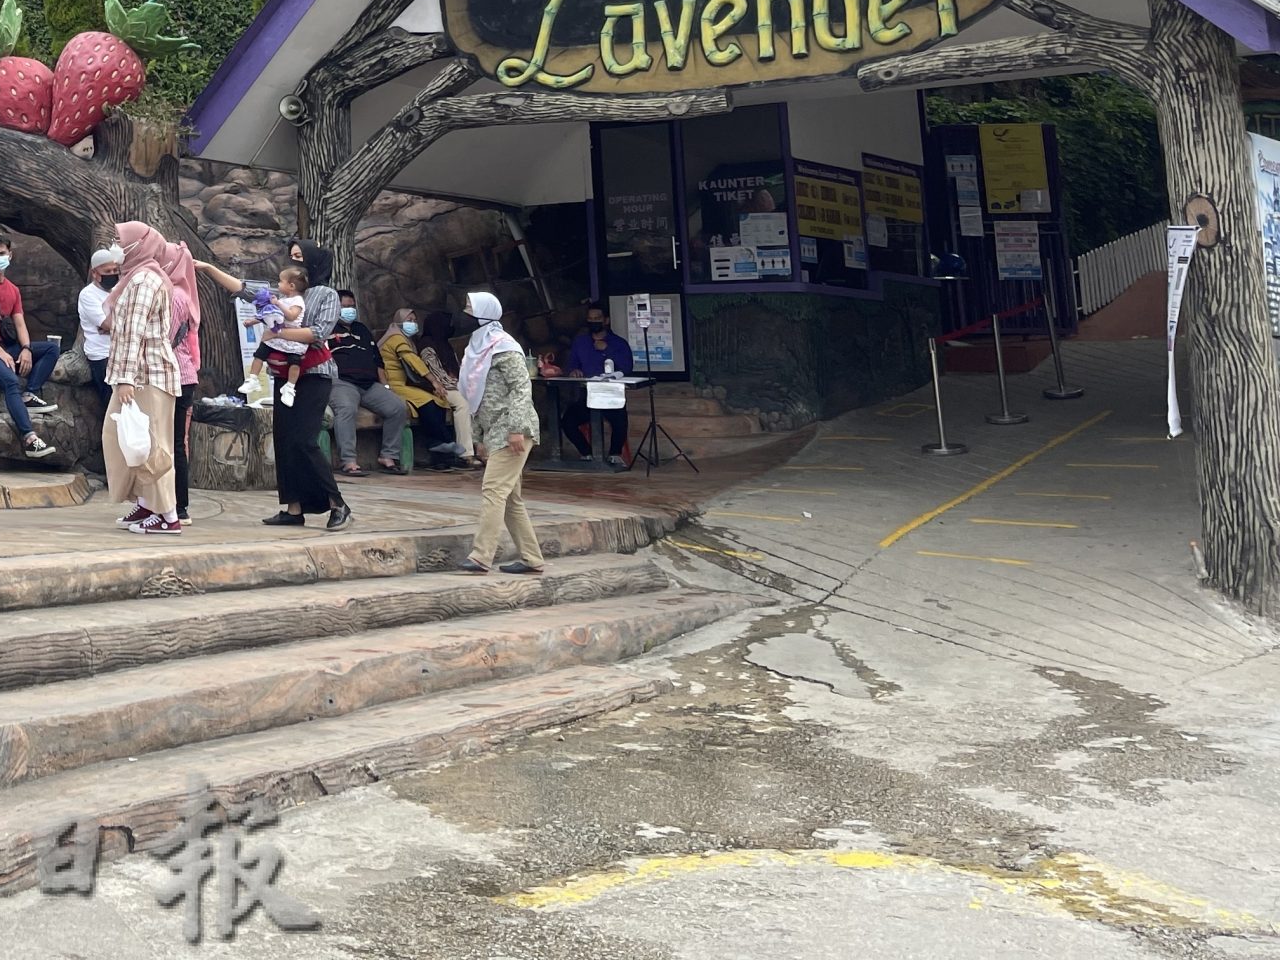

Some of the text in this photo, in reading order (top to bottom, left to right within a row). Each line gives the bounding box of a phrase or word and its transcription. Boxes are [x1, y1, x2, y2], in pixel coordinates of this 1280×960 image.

[698, 175, 765, 190] KAUNTER
[608, 192, 668, 205] OPERATING
[713, 189, 755, 202] TIKET
[623, 204, 654, 214] HOUR
